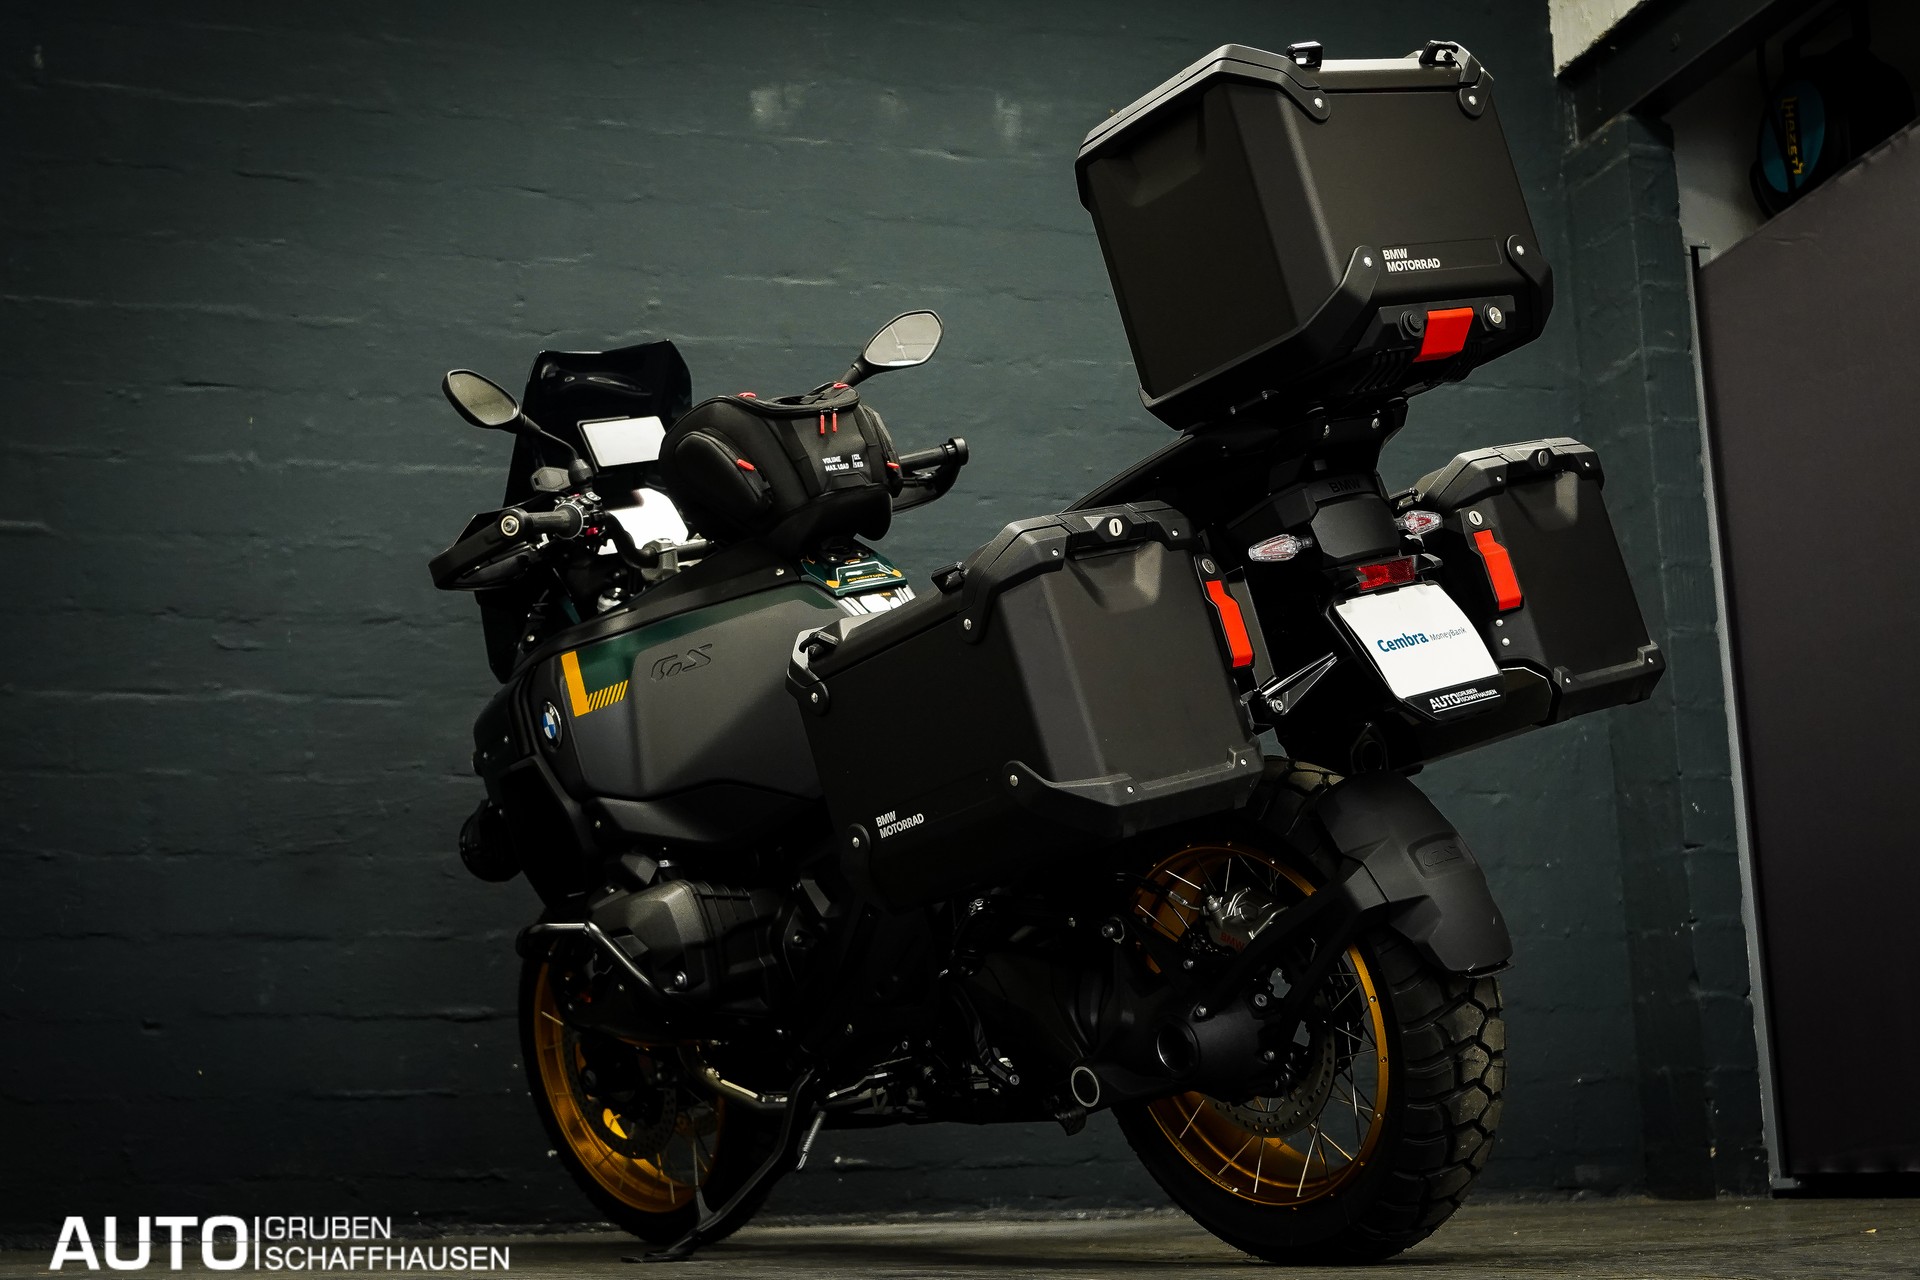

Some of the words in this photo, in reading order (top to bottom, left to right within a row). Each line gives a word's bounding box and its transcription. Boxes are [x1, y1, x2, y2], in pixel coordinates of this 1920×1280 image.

[1382, 248, 1408, 260] BMW
[1386, 257, 1441, 273] MOTORRAD
[1328, 479, 1361, 493] BMW
[1377, 632, 1429, 653] Cembra
[1429, 626, 1467, 642] MoneyBank
[651, 643, 712, 682] GS
[1429, 692, 1461, 710] AUTO
[875, 810, 896, 828] BMW
[879, 812, 925, 839] MOTORRAD
[1220, 932, 1245, 953] BMW
